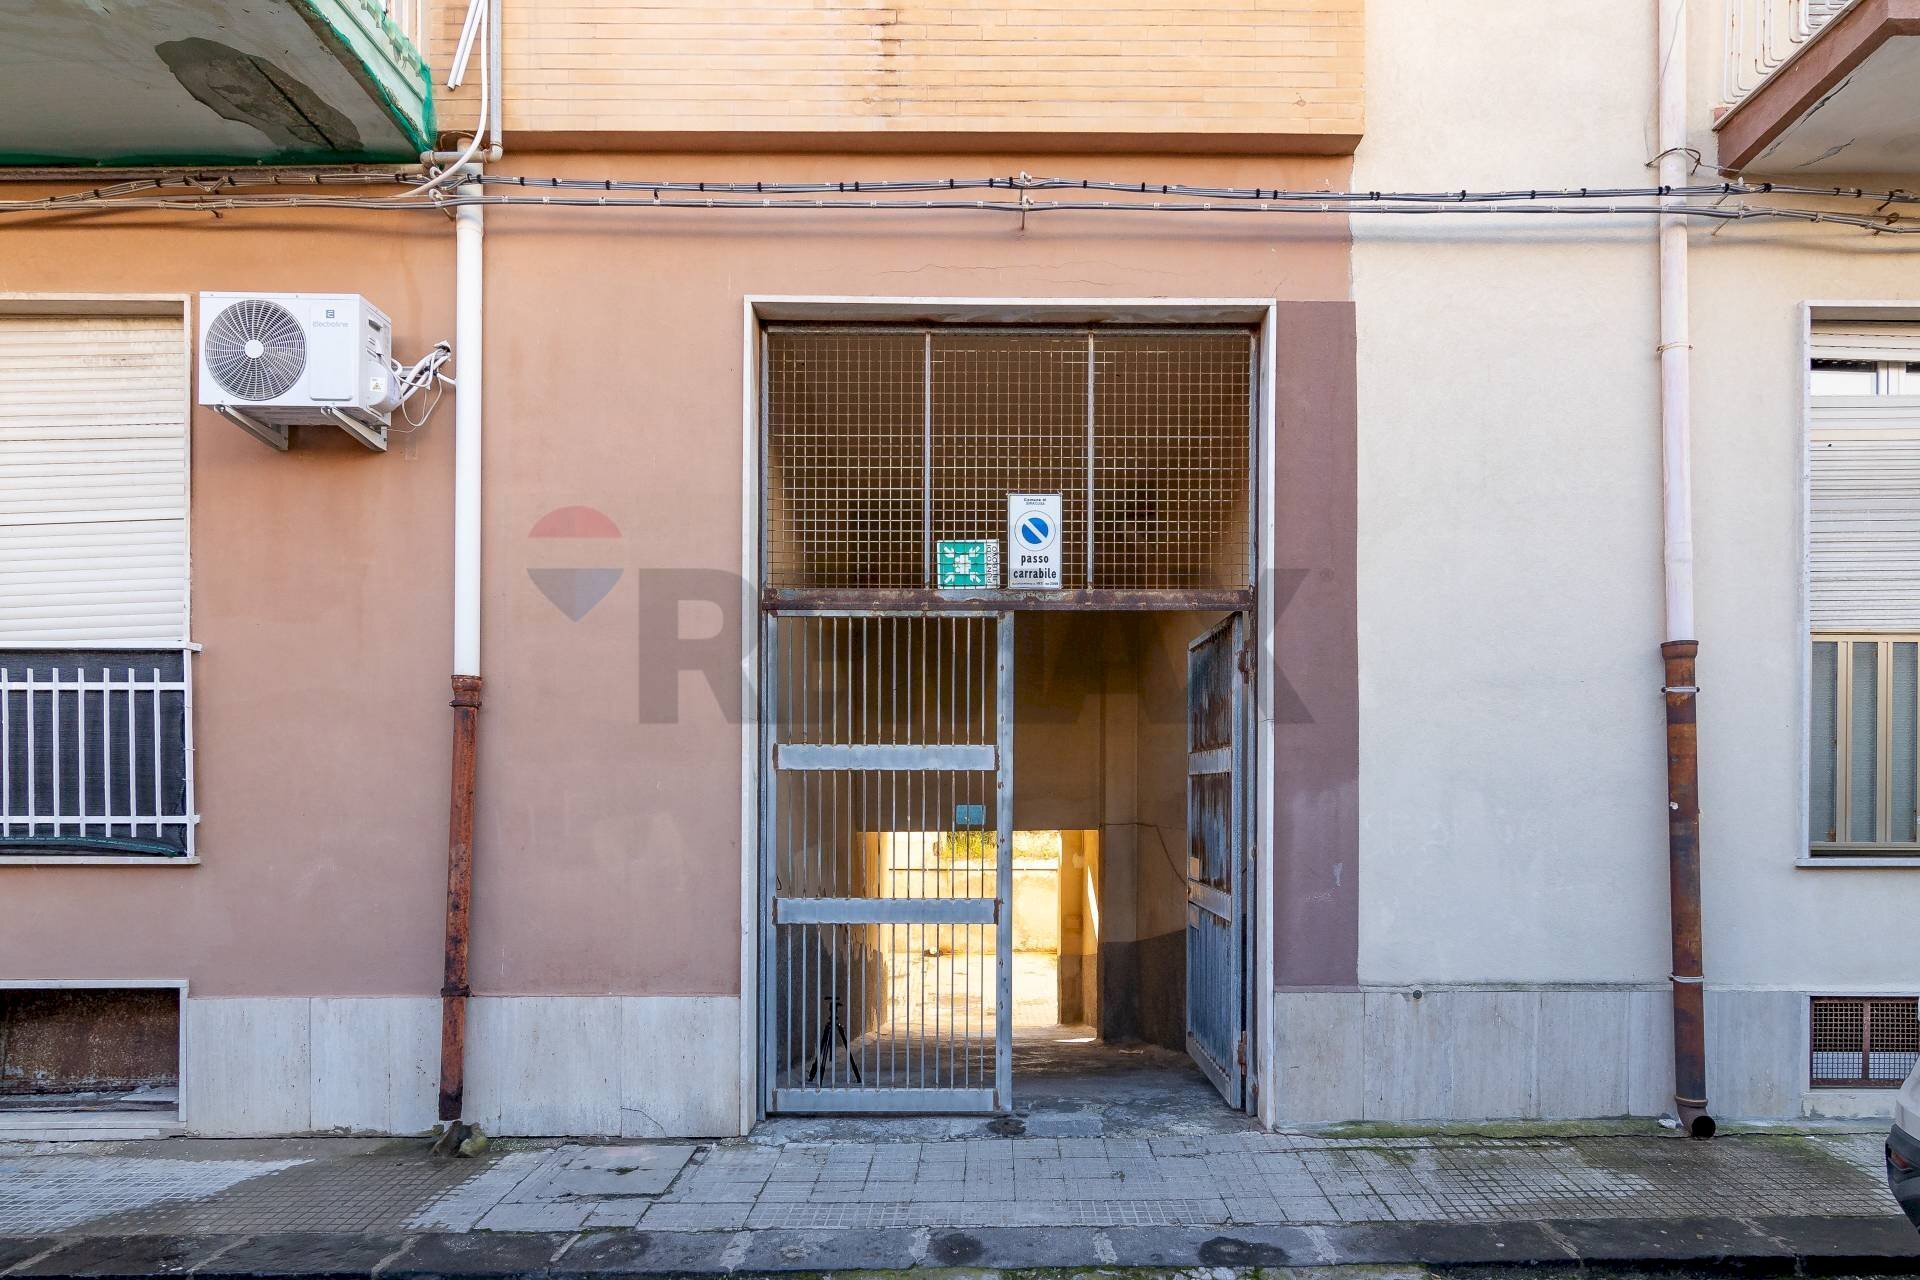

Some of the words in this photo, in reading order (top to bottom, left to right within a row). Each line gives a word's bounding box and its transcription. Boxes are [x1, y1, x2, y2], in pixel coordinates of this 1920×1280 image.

[986, 544, 992, 553] DI
[1021, 555, 1049, 566] passo
[1013, 568, 1057, 579] carrabile
